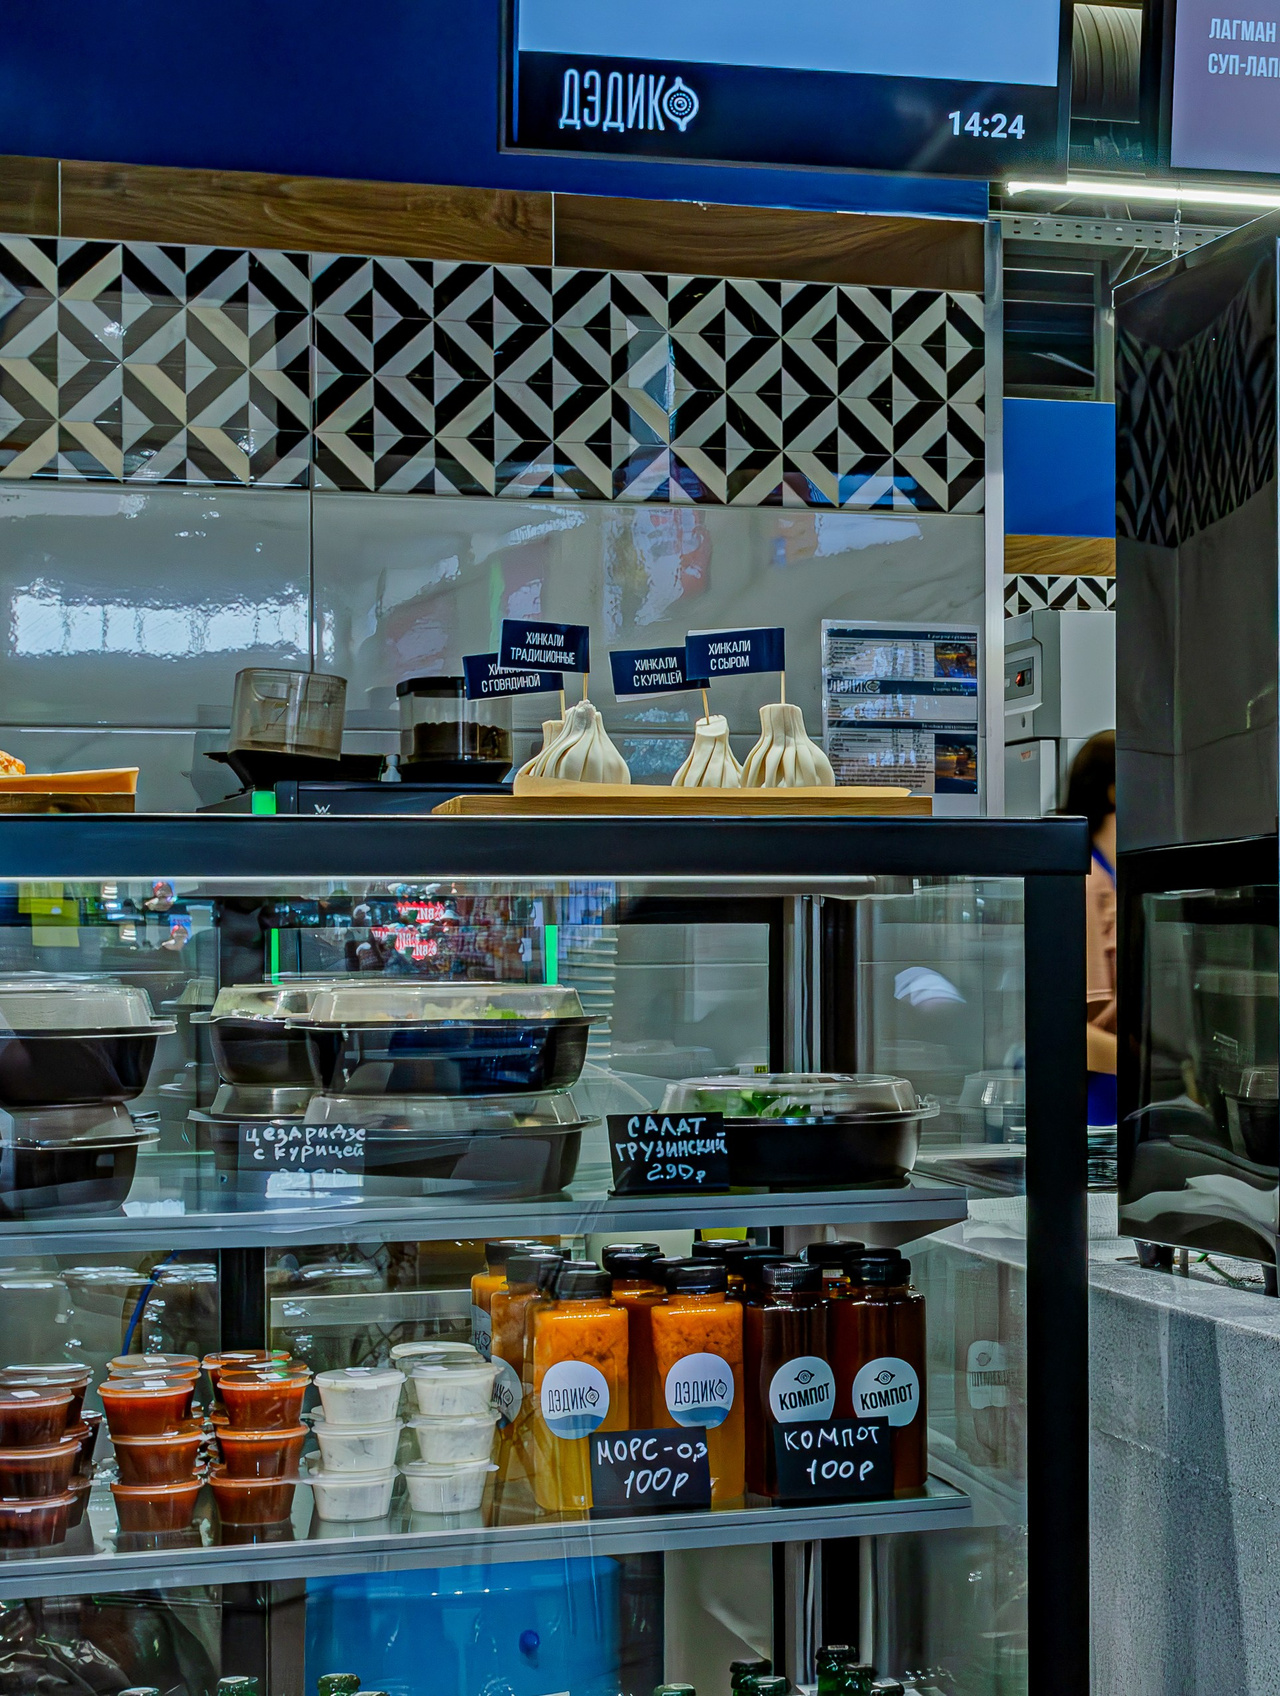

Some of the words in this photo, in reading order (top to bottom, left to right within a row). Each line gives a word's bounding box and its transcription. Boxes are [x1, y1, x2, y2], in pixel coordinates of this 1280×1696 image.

[1208, 18, 1276, 43] ЛАГМАН
[948, 111, 1025, 139] 14:24
[526, 632, 564, 647] ХИНКАЛИ
[708, 640, 751, 656] ХИНКАЛИ
[510, 647, 576, 665] ТРАДИЦИОННЫЕ
[635, 657, 678, 672] ХИНКАЛИ
[710, 658, 717, 671] С
[720, 655, 750, 670] СЫРОМ
[481, 680, 488, 693] С
[489, 673, 541, 692] ГОВЯДИНОЙ
[633, 675, 640, 687] С
[642, 670, 682, 686] КУРИЦЕЙ
[778, 1382, 831, 1411] КОМПОТ
[860, 1383, 914, 1411] КОМПОТ
[784, 1426, 880, 1451] КОМПОТ
